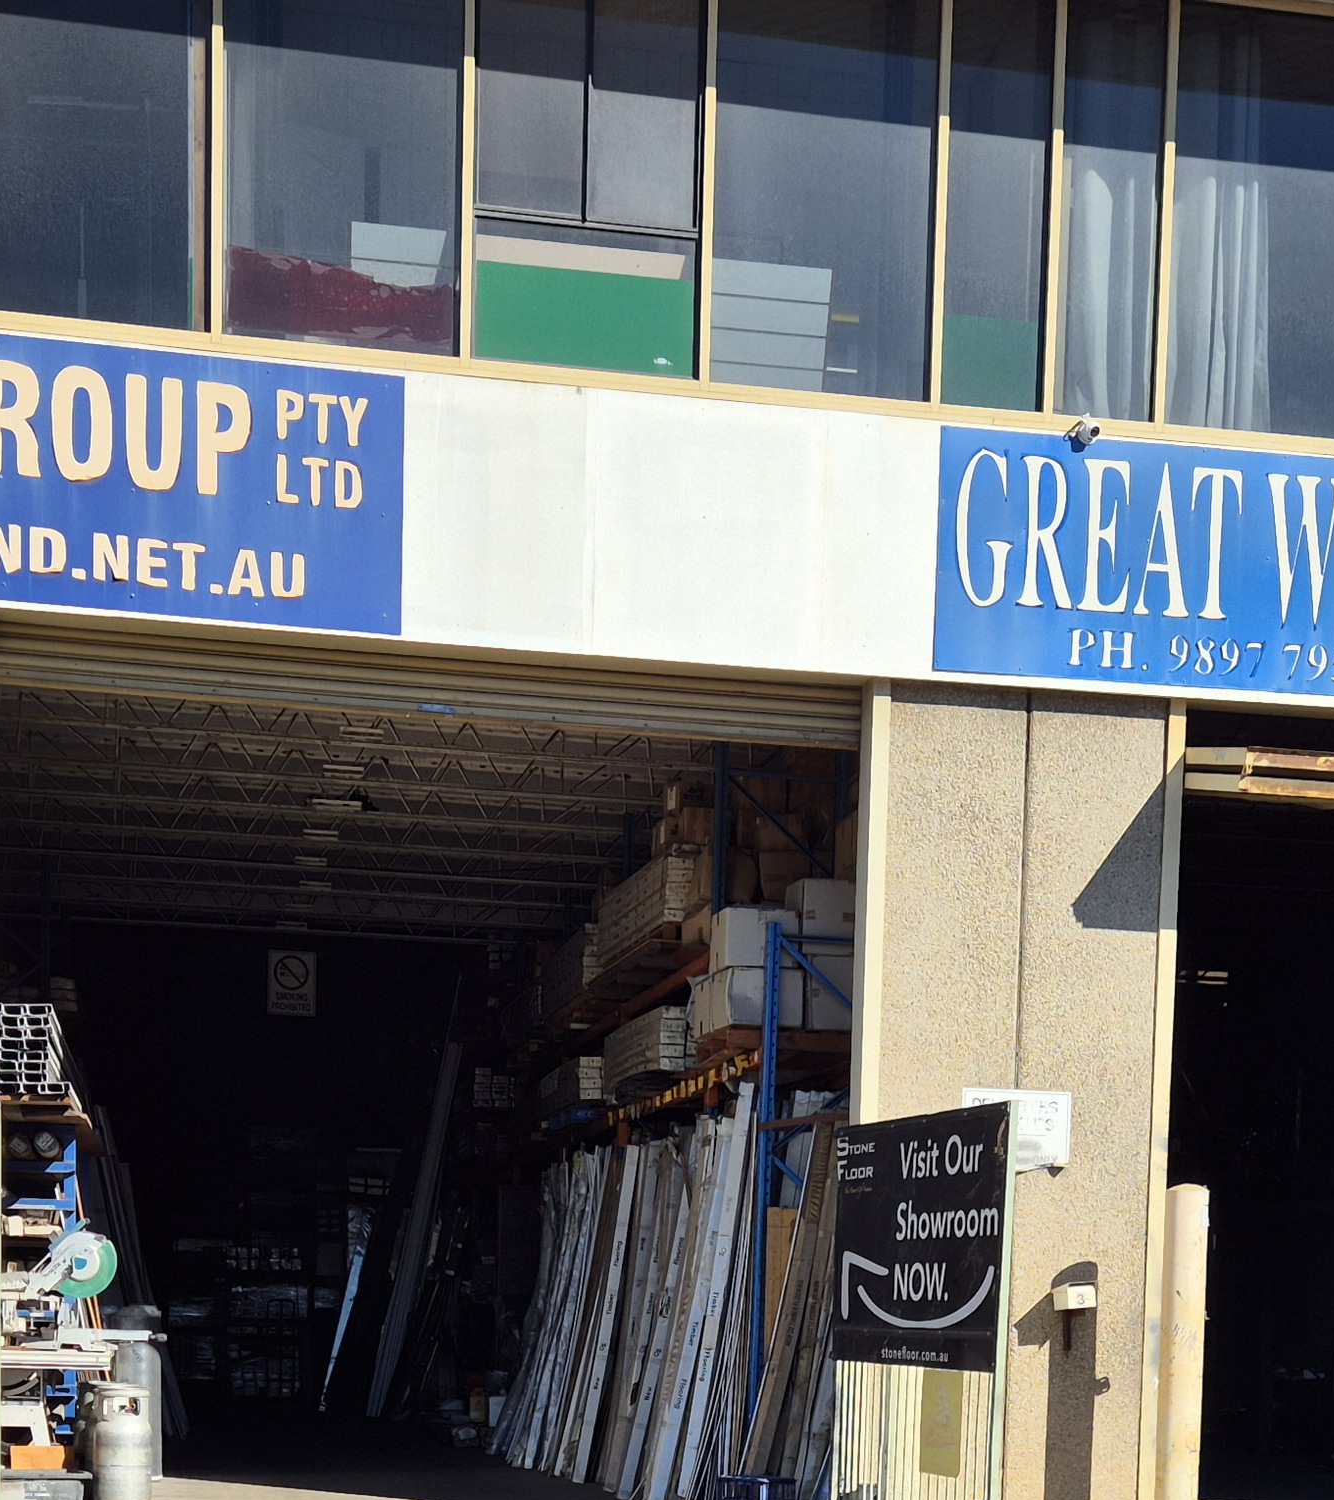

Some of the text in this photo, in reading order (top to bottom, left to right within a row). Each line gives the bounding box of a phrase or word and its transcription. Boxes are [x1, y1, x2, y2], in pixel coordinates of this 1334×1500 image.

[276, 388, 369, 447] PTY
[276, 453, 364, 510] LTD
[956, 447, 1243, 621] GREAT
[1067, 628, 1149, 671] PH.
[1170, 634, 1266, 679] 9897
[836, 1136, 876, 1157] STONE
[899, 1138, 939, 1181] Visit
[944, 1134, 984, 1176] Our
[837, 1160, 874, 1181] FLOOR
[895, 1200, 999, 1242] Showroom
[893, 1262, 949, 1302] NOW.
[1077, 1293, 1086, 1305] 3
[688, 1320, 698, 1347] Timber
[881, 1346, 949, 1363] stonefloor.com.au
[674, 1378, 687, 1410] Flooring
